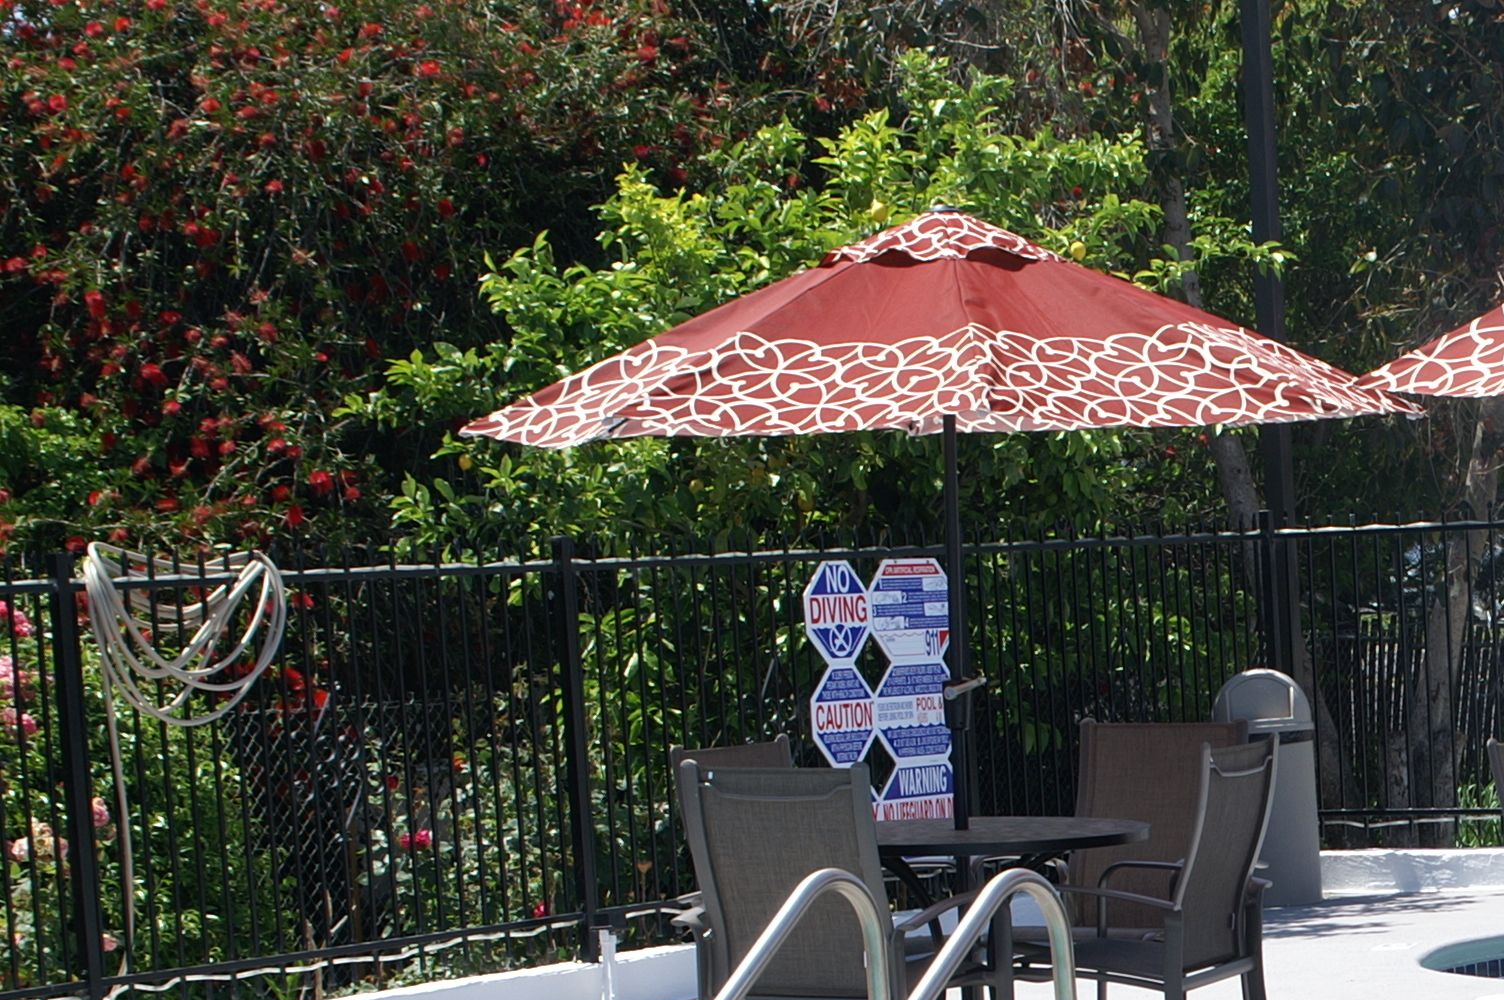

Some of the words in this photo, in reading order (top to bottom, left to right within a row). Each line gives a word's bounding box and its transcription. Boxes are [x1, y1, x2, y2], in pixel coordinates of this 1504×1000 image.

[825, 565, 850, 593] NO
[810, 595, 868, 625] DIVING
[925, 630, 940, 657] 911
[816, 702, 873, 731] CAUTION
[916, 697, 936, 711] POOL
[898, 766, 947, 796] WARNING
